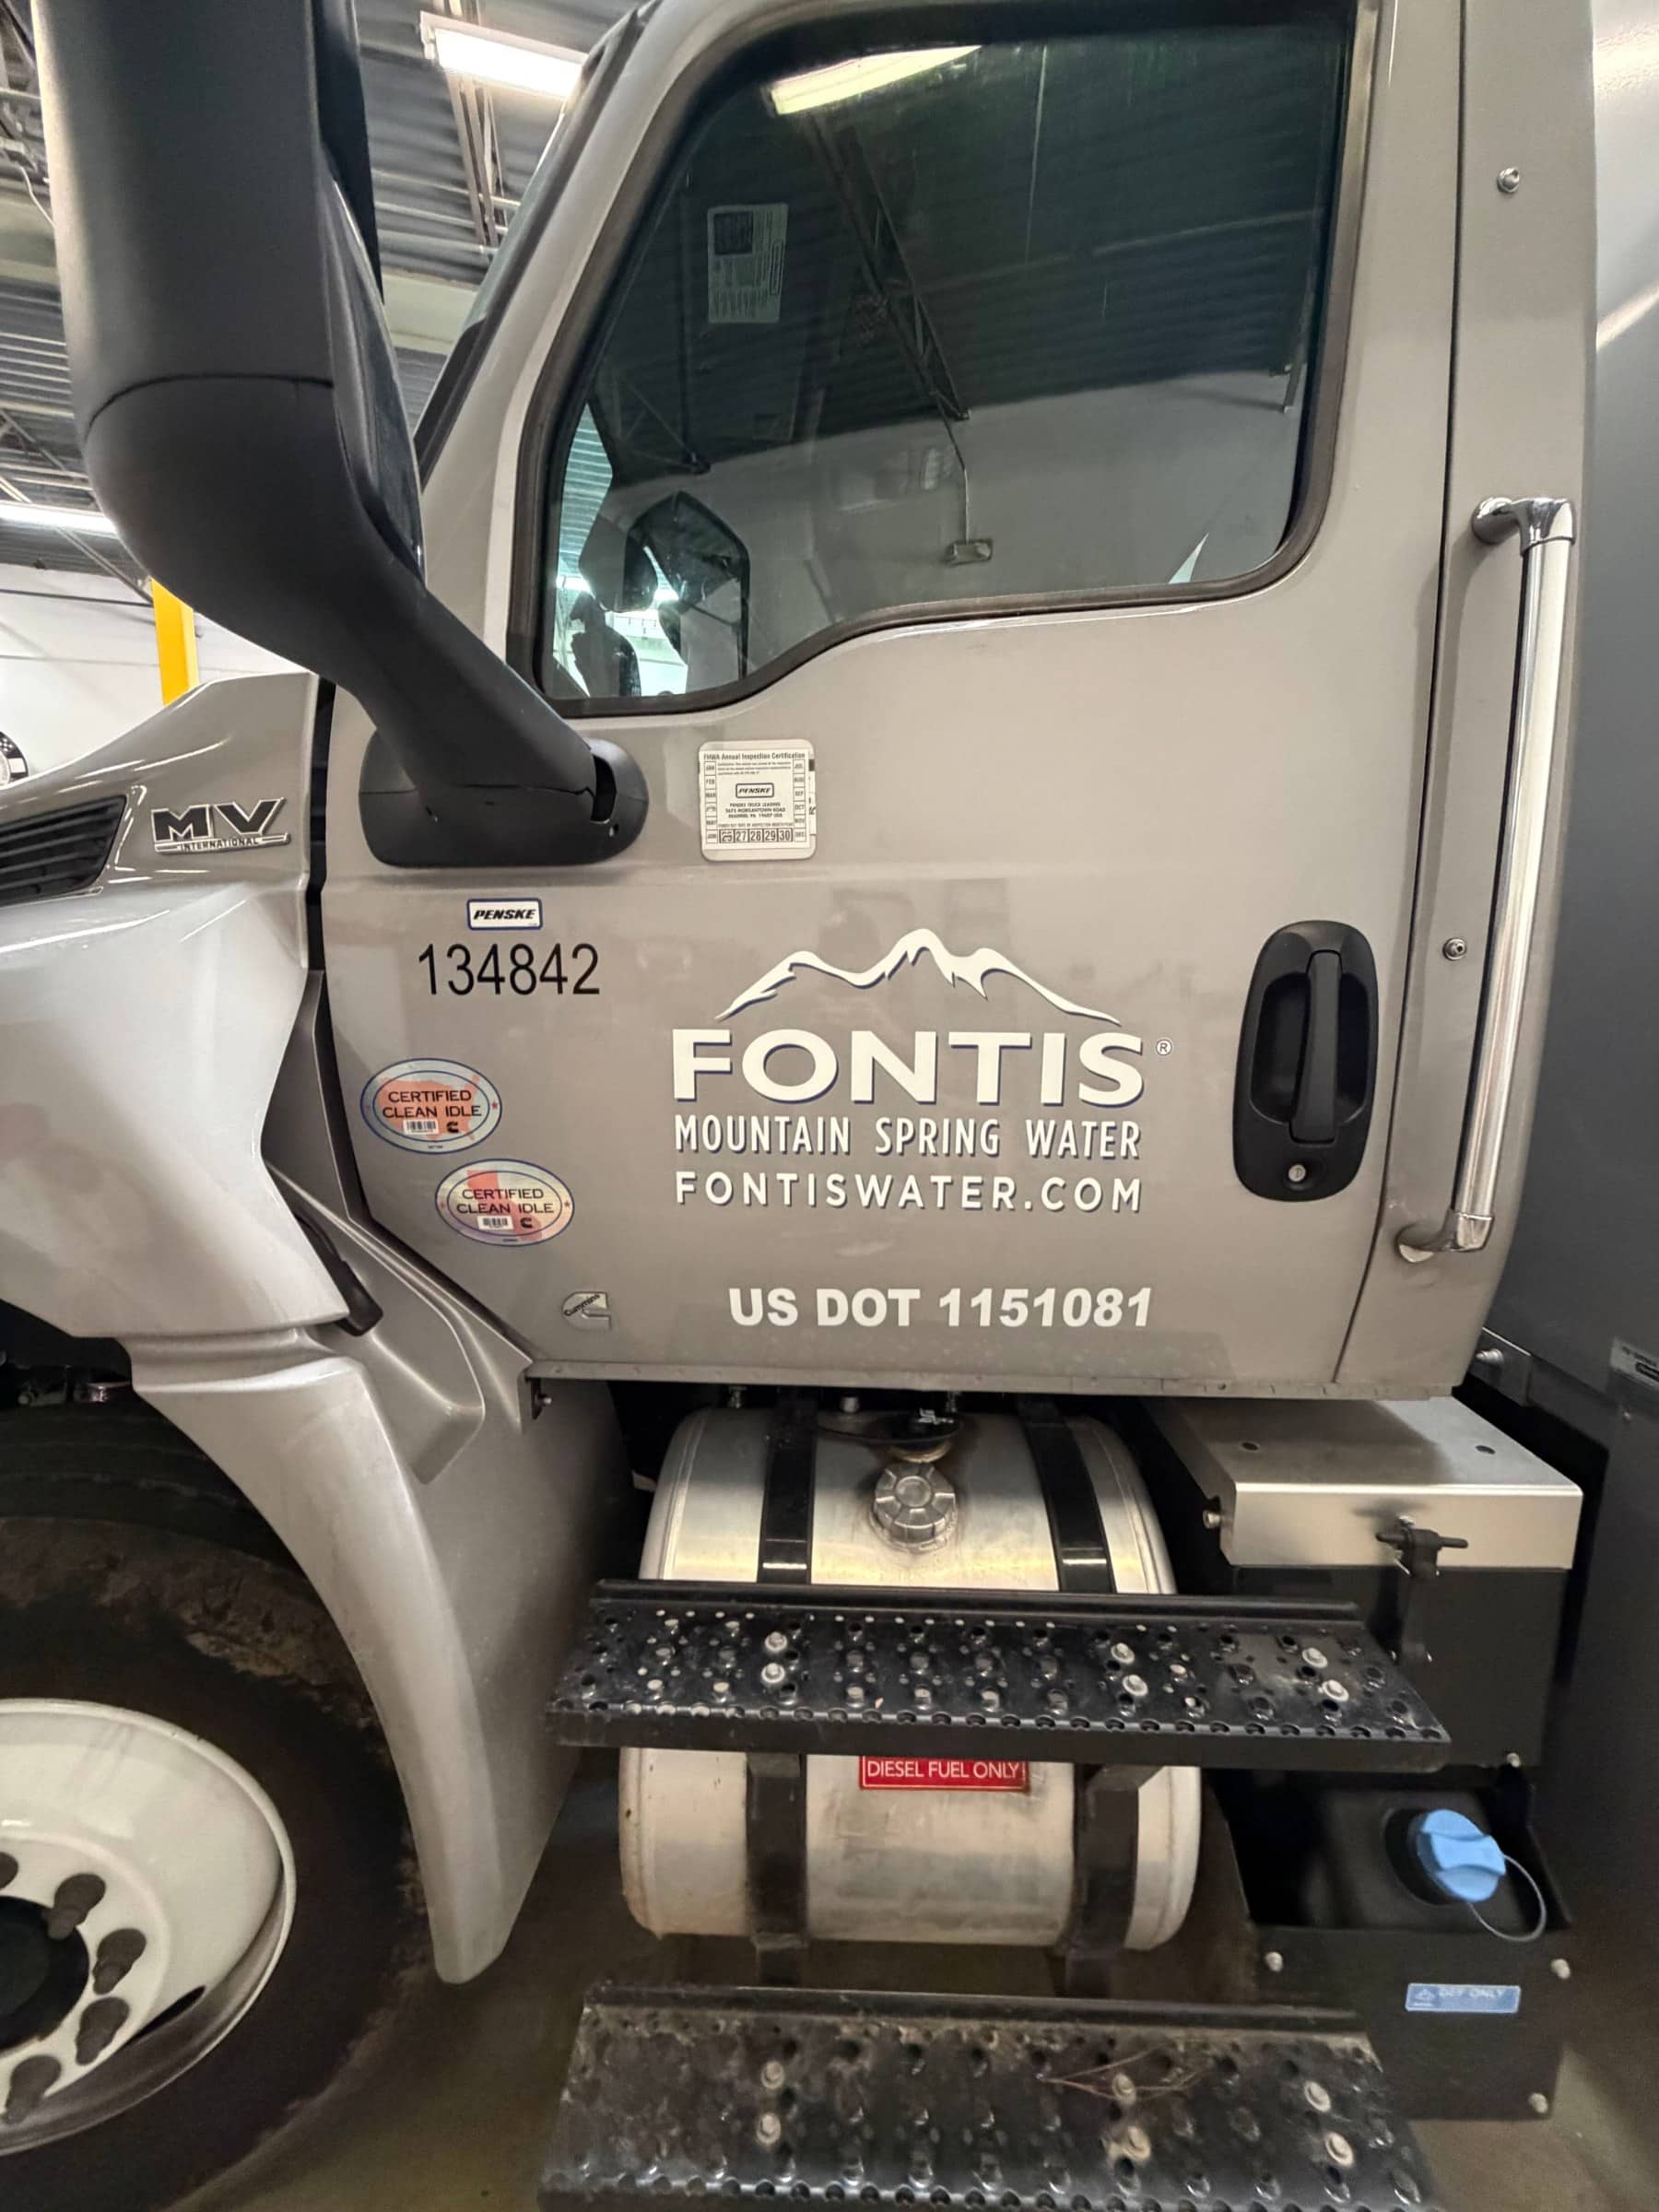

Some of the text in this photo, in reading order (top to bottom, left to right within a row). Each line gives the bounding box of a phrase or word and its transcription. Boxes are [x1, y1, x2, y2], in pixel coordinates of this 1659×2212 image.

[742, 752, 771, 760] Inspection
[771, 751, 806, 759] Certification
[151, 797, 284, 842] MV
[735, 830, 747, 841] 27
[750, 830, 761, 841] 28
[765, 830, 776, 841] 29
[780, 830, 791, 841] 30
[181, 837, 259, 852] INTERNATIONAL
[473, 909, 536, 920] PENSKE
[418, 943, 600, 996] 134842
[672, 1029, 1145, 1107] FONTIS
[388, 1089, 472, 1103] CERTIFIED
[382, 1105, 482, 1119] CLEAN IDLE
[675, 1114, 1141, 1159] MOUNTAIN SPRING WATER
[462, 1188, 544, 1200] CERTIFIED
[676, 1171, 1142, 1213] FONTISWATER.COM
[456, 1203, 555, 1214] CLEAN IDLE
[729, 1287, 1152, 1327] US DOT 1151081
[867, 1760, 1019, 1779] DIESEL FUEL ONLY
[1469, 1988, 1504, 1999] ONLY
